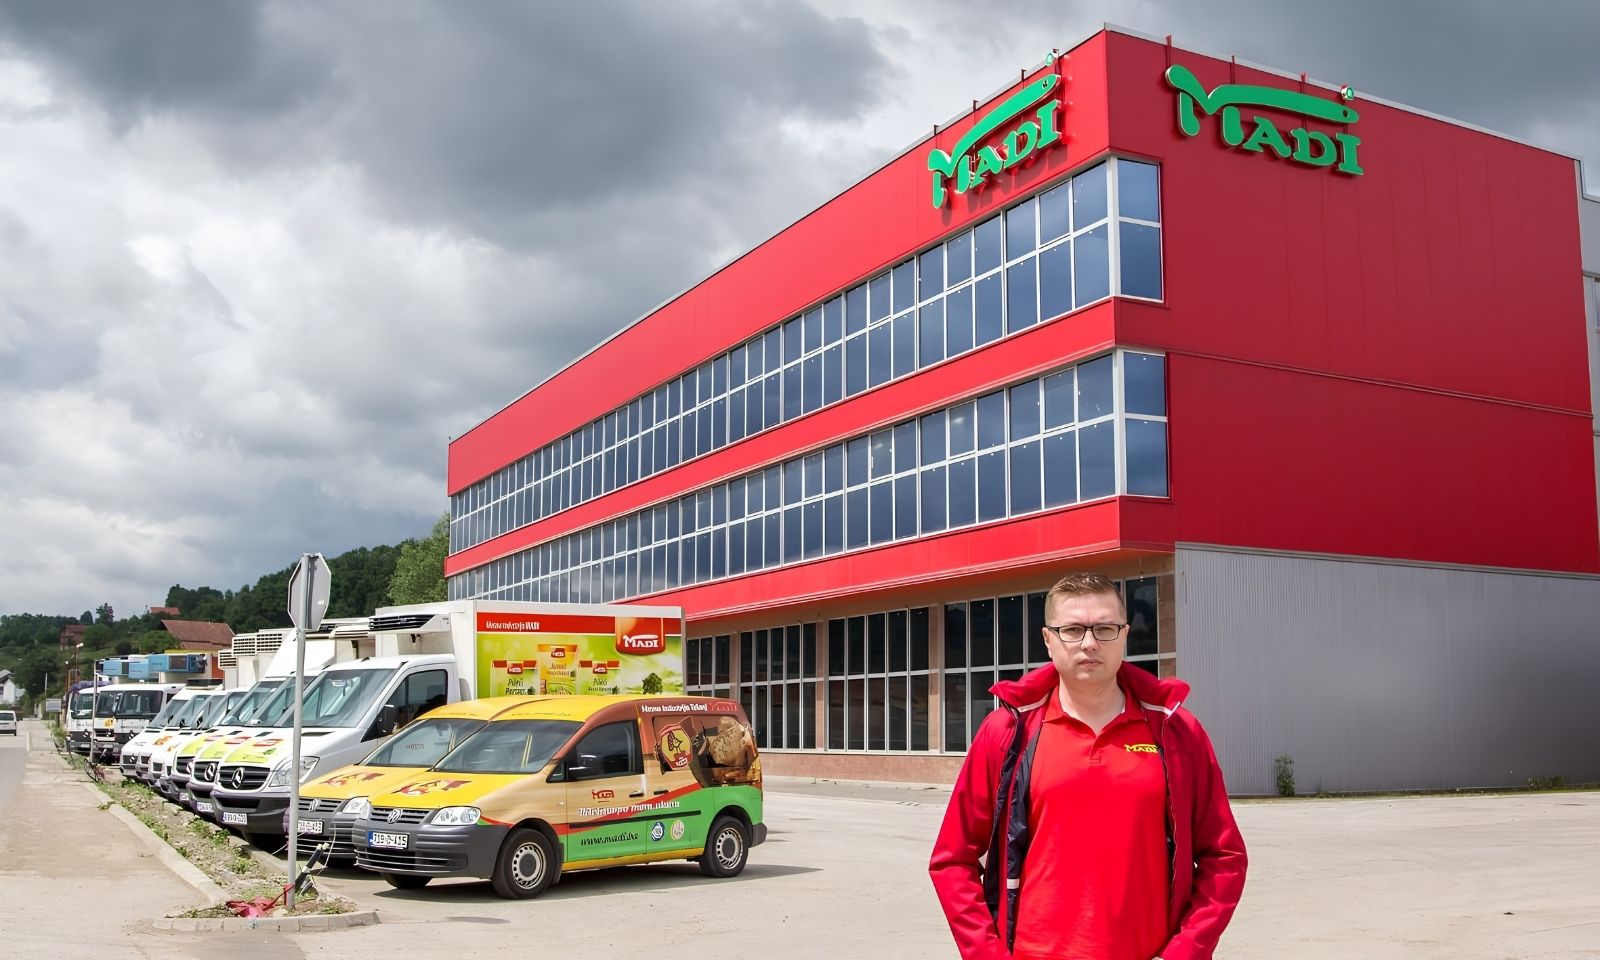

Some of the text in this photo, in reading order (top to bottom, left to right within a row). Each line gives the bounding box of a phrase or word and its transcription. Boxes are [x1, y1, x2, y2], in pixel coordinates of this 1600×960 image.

[927, 73, 1062, 209] MADI
[1165, 64, 1365, 177] MADI
[622, 634, 659, 648] MADI
